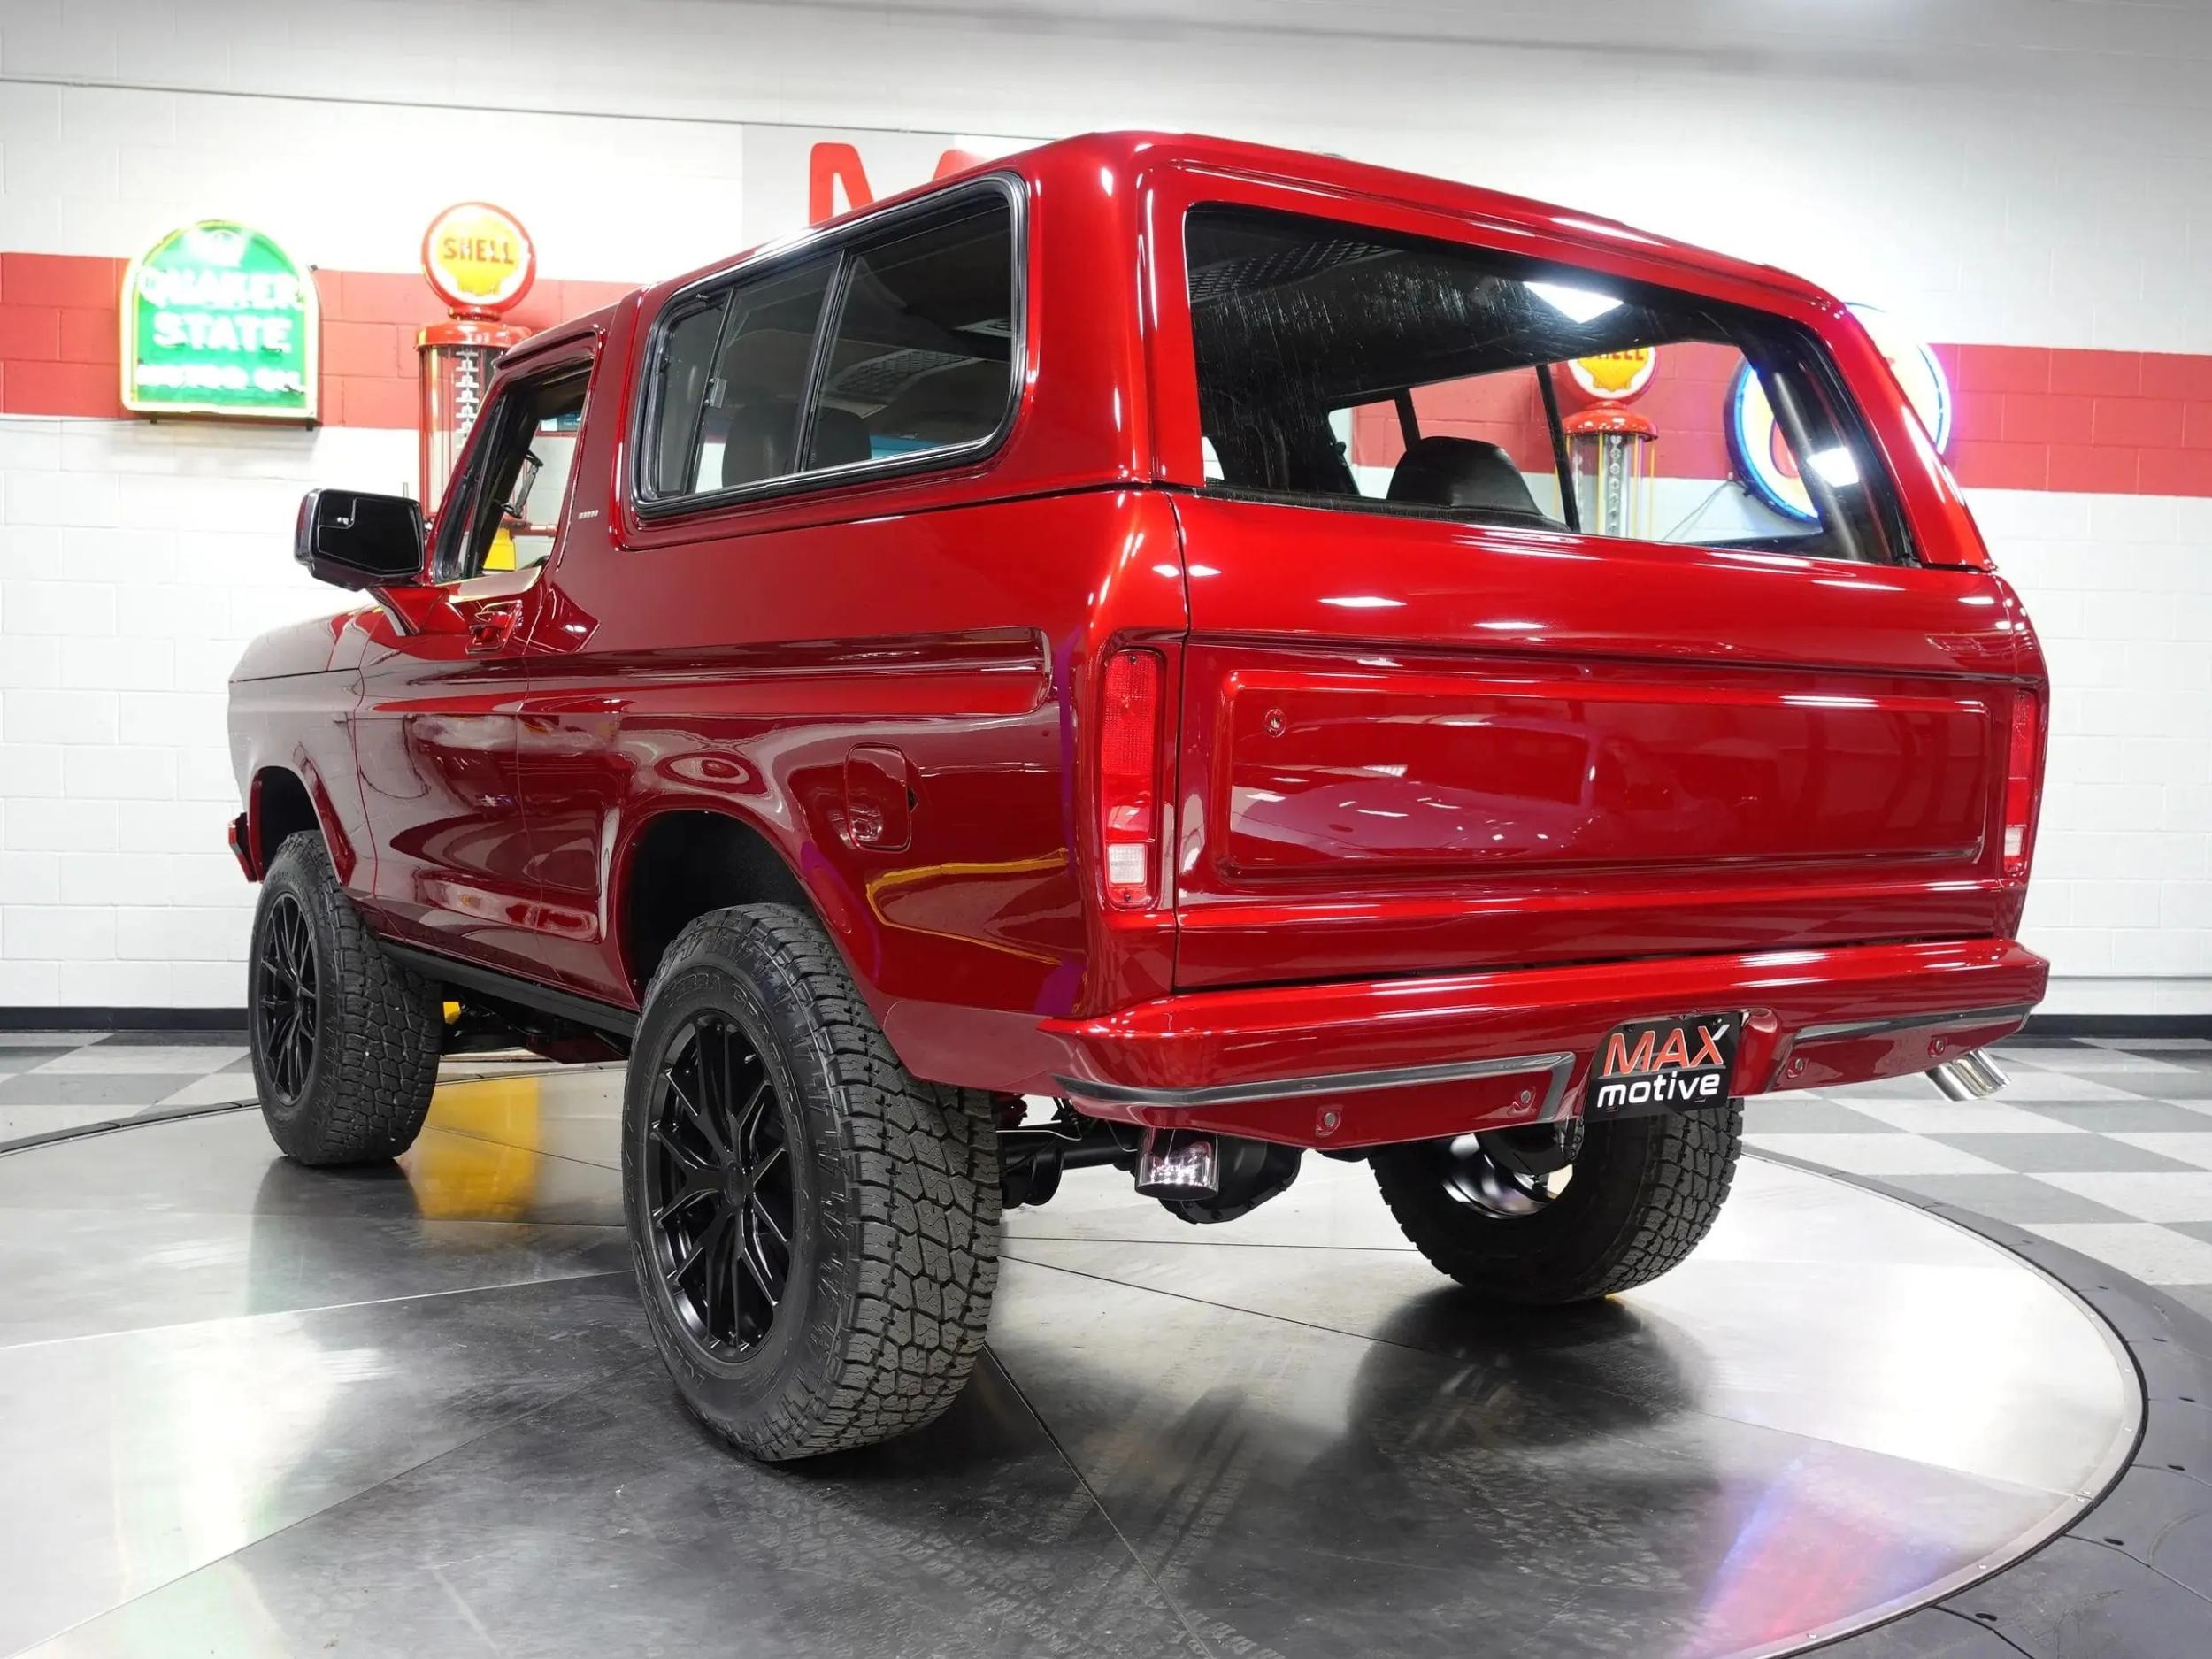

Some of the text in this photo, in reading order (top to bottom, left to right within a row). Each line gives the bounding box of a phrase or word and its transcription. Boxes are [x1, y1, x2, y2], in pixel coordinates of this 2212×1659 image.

[443, 237, 515, 265] SHELL
[153, 311, 292, 353] STATE
[1603, 1024, 1730, 1077] MAX
[1597, 1071, 1721, 1107] motive
